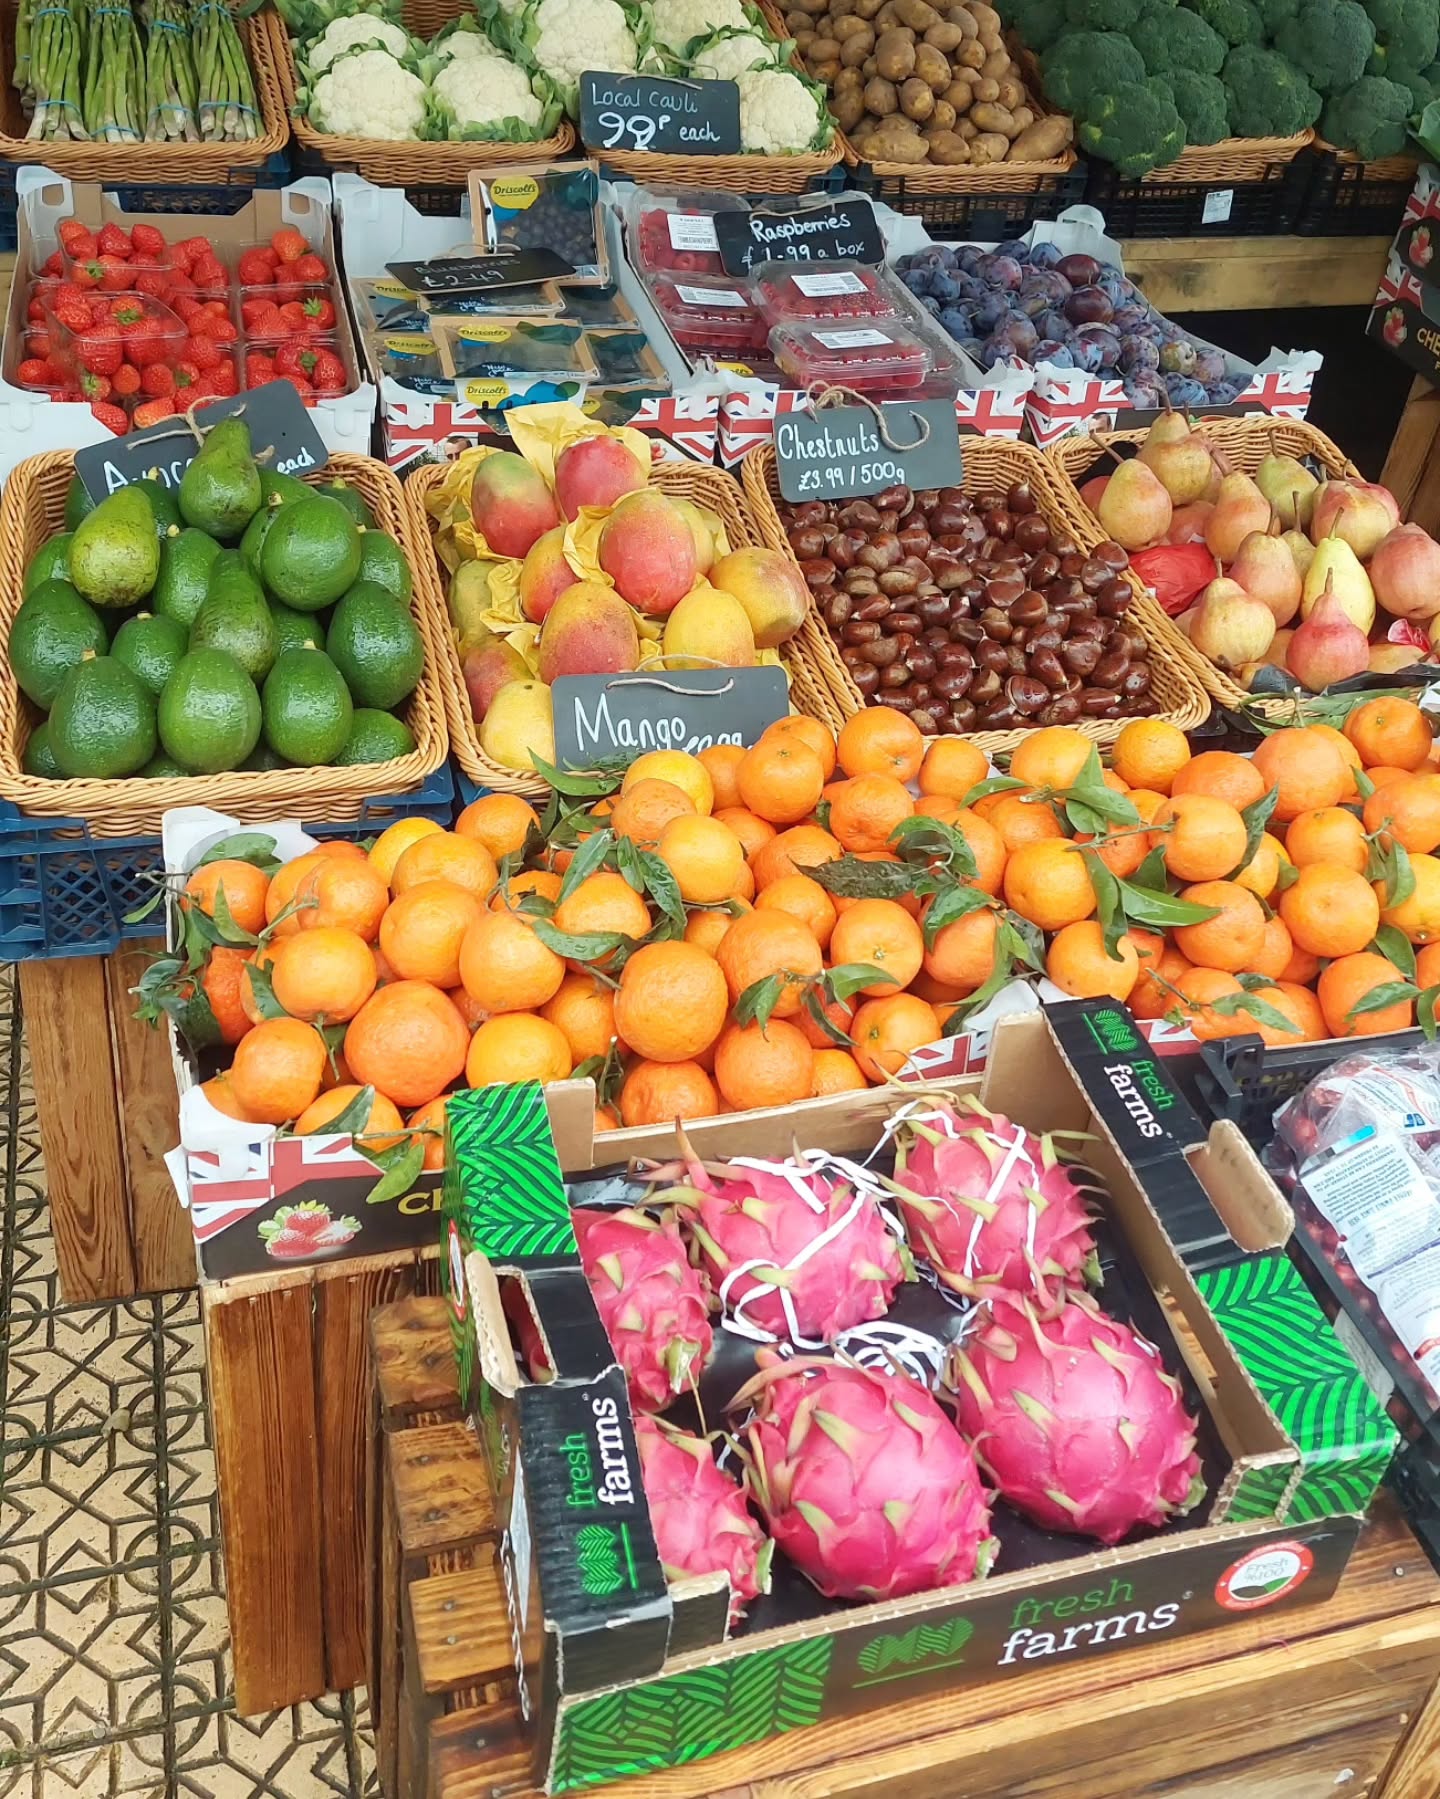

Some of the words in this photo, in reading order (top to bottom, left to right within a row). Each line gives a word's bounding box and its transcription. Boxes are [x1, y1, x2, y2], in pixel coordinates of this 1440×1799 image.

[592, 82, 640, 107] Local
[679, 120, 721, 142] each
[750, 213, 851, 243] Raspberries
[835, 239, 865, 256] box
[778, 423, 879, 460] Chestnuts
[574, 693, 686, 751] Mango
[1103, 1063, 1164, 1137] farms
[1131, 1060, 1175, 1111] fresh
[559, 1432, 597, 1509] fresh
[592, 1397, 635, 1507] farms
[1008, 1577, 1135, 1629] fresh
[997, 1602, 1180, 1666] farms
